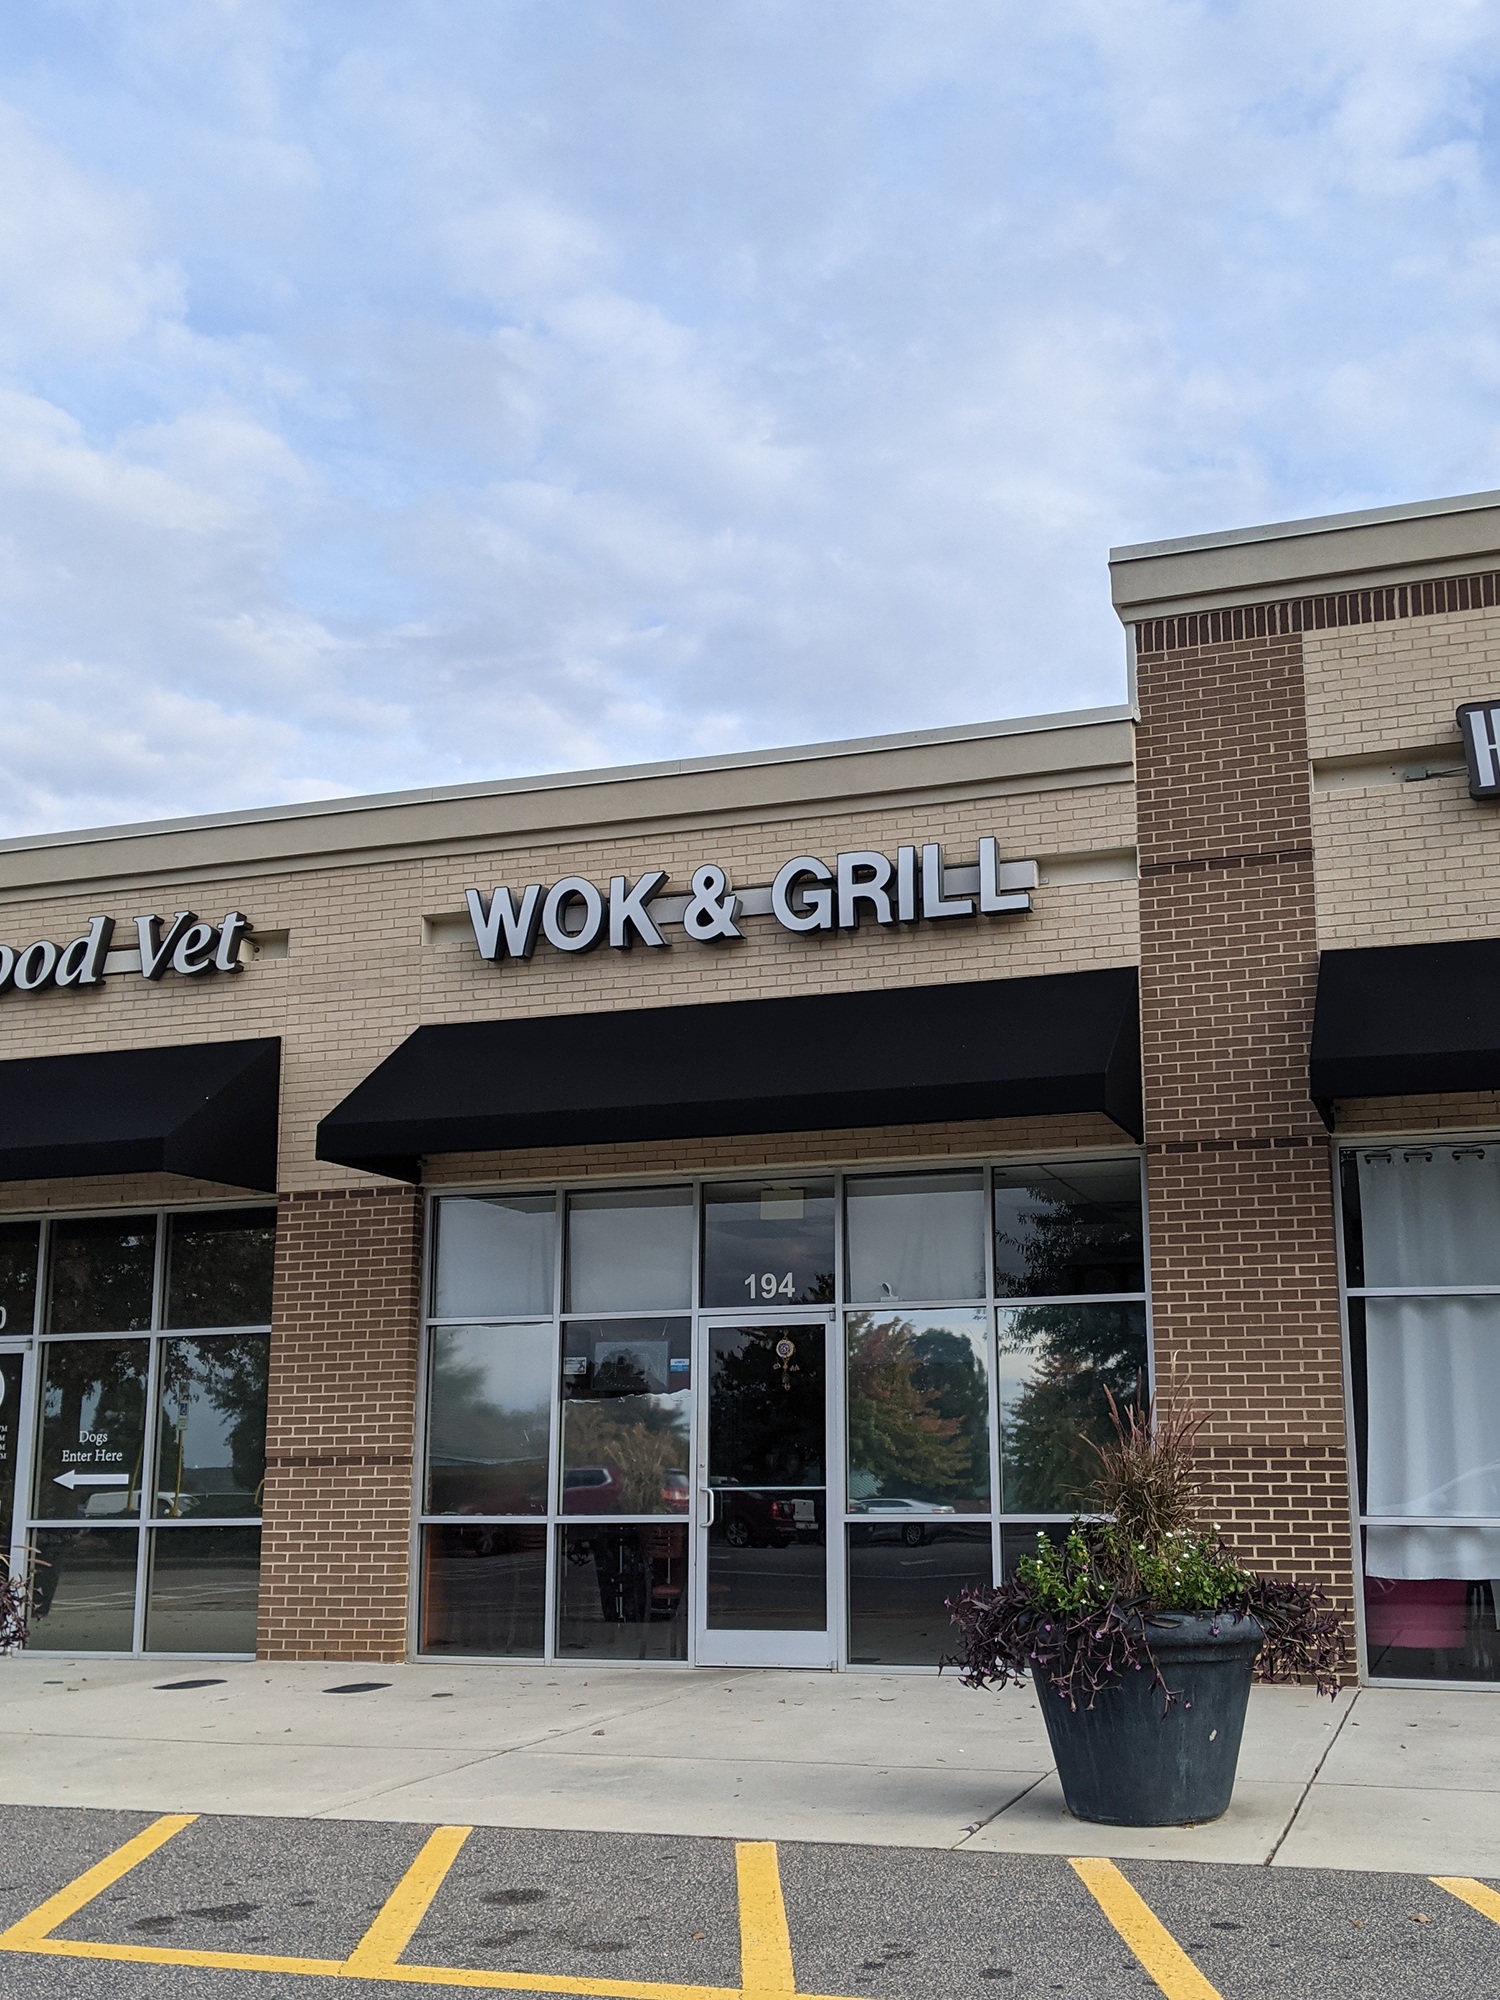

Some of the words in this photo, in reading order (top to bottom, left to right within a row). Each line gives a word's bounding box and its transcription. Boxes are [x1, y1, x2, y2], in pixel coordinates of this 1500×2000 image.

[465, 871, 672, 962] WOK
[683, 864, 747, 943] &
[771, 836, 1034, 935] GRILL
[133, 911, 251, 981] Vet
[744, 1272, 796, 1299] 194
[79, 1430, 108, 1446] Dogs
[61, 1449, 92, 1462] Enter
[94, 1449, 123, 1462] Here
